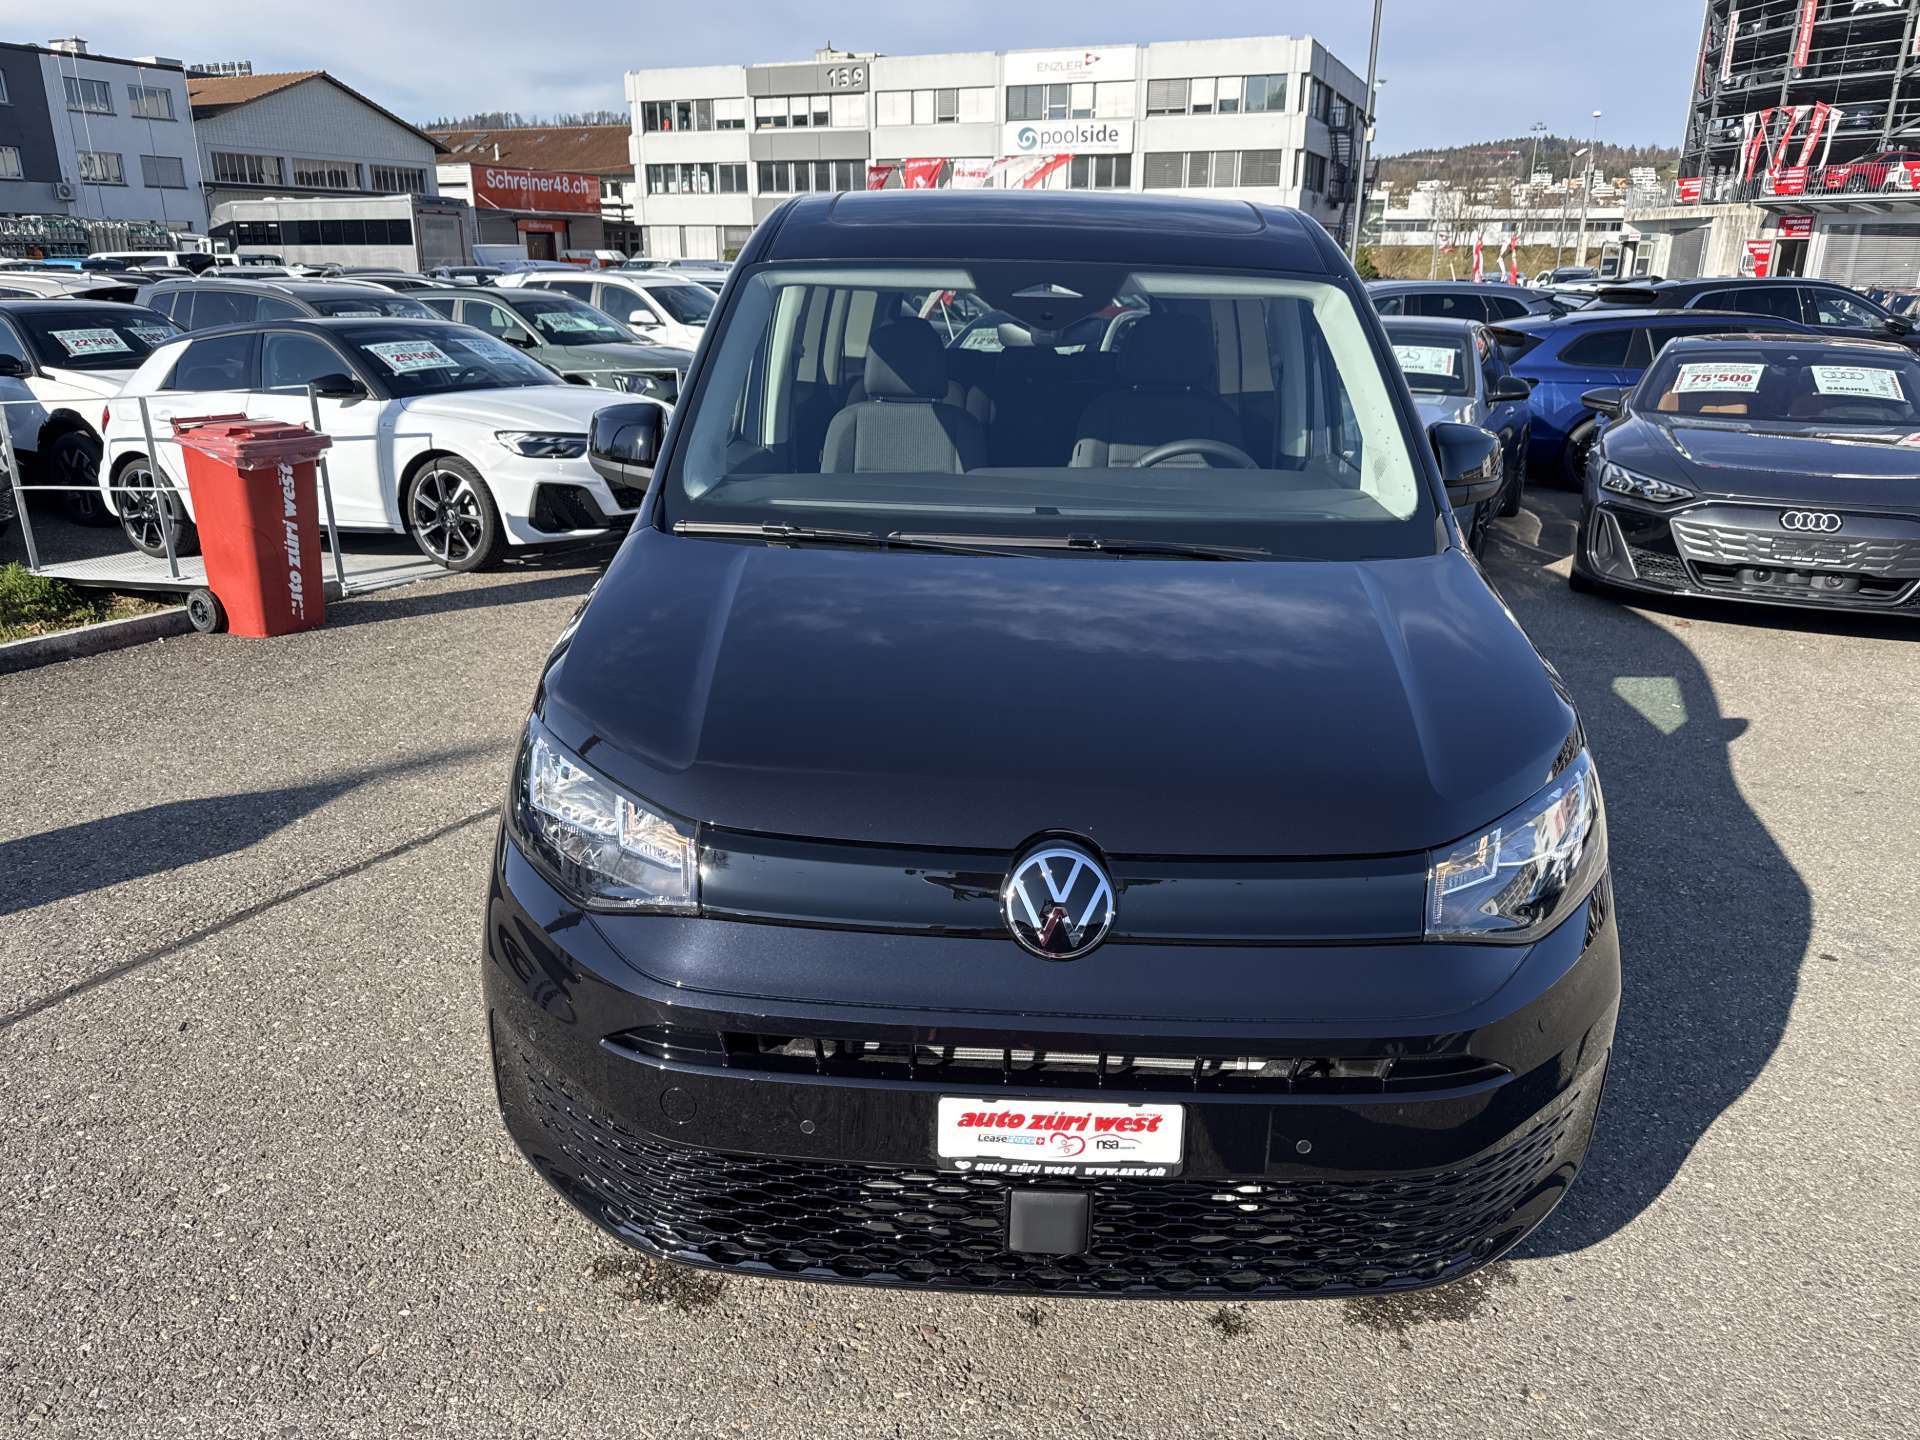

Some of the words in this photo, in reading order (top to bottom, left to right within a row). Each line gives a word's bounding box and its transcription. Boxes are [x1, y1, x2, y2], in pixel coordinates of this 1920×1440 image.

[827, 67, 864, 87] 139
[1036, 61, 1083, 72] ENZLER
[1040, 124, 1119, 149] poolside
[486, 169, 589, 194] Schreiner48.ch
[73, 337, 119, 347] 22'500
[1691, 374, 1753, 383] 75'500
[278, 462, 297, 517] west
[282, 519, 301, 569] züri
[288, 570, 304, 620] uto
[1006, 848, 1113, 958] VW
[957, 1110, 1025, 1129] auto
[1026, 1111, 1092, 1131] züri
[1093, 1114, 1163, 1132] west
[1096, 1140, 1119, 1150] nsa
[975, 1161, 1007, 1172] auto
[1009, 1162, 1040, 1174] züri
[1044, 1165, 1077, 1175] west
